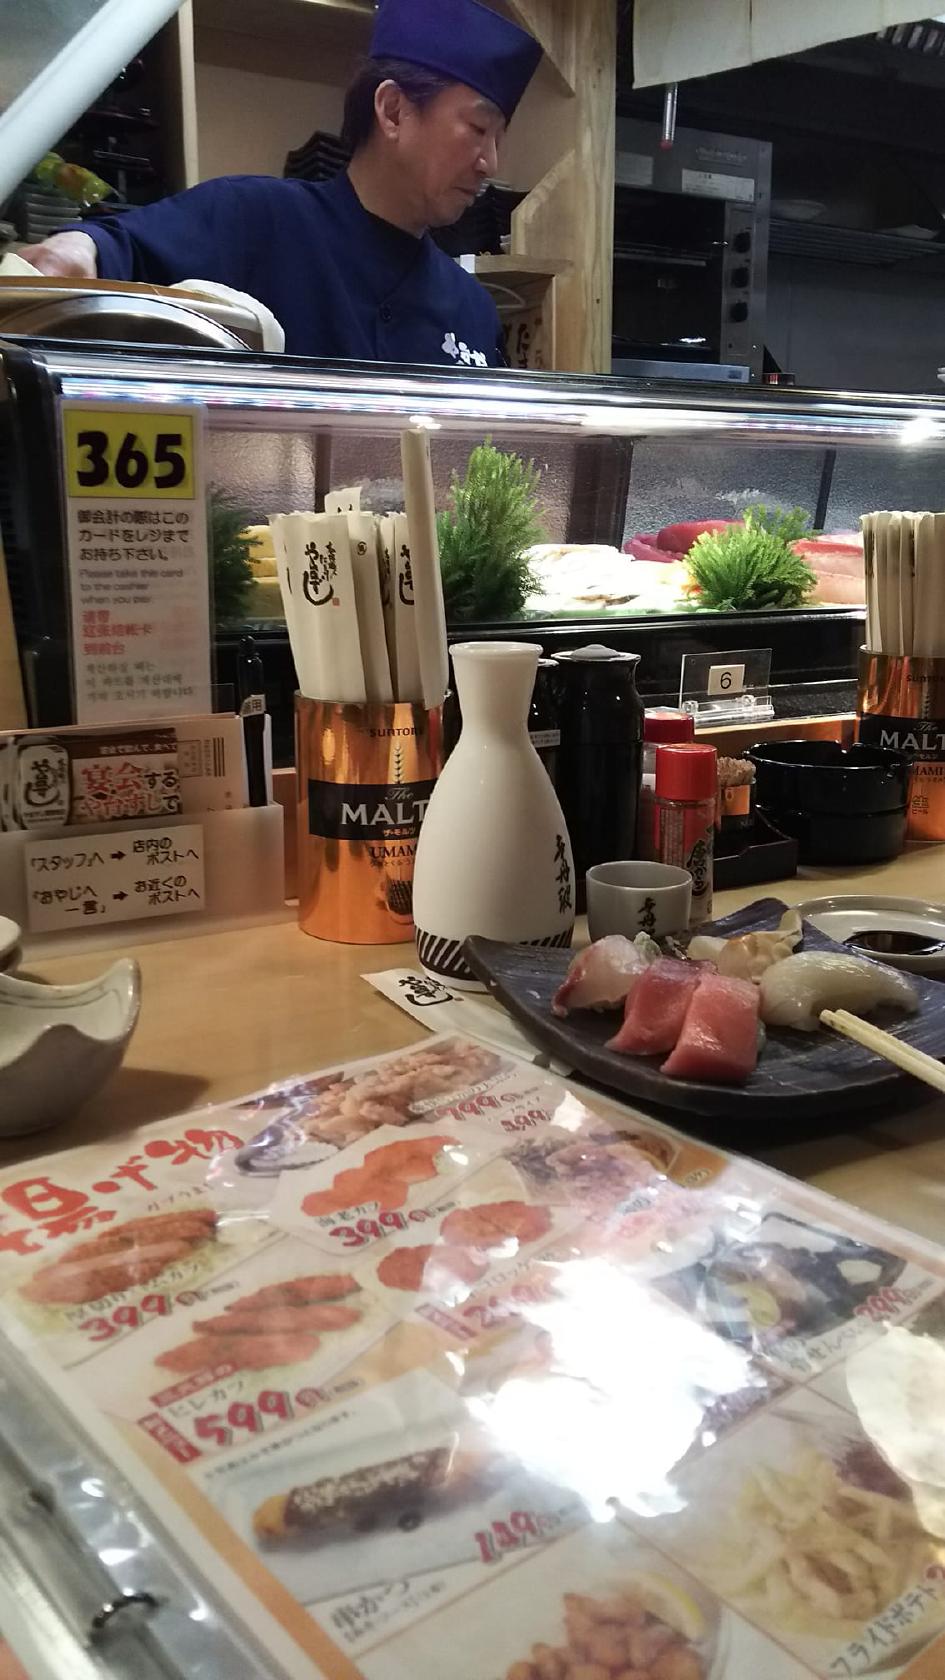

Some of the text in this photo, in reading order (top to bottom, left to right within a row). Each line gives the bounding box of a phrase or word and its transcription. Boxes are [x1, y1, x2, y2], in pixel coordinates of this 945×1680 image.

[76, 431, 186, 488] 365
[79, 530, 189, 543] カードをレジまで
[720, 672, 732, 689] 6
[385, 787, 414, 800] The
[133, 837, 172, 854] 店内の
[147, 849, 199, 866] ポストへ
[134, 875, 187, 893] お近くの
[148, 888, 200, 905] ポストへ
